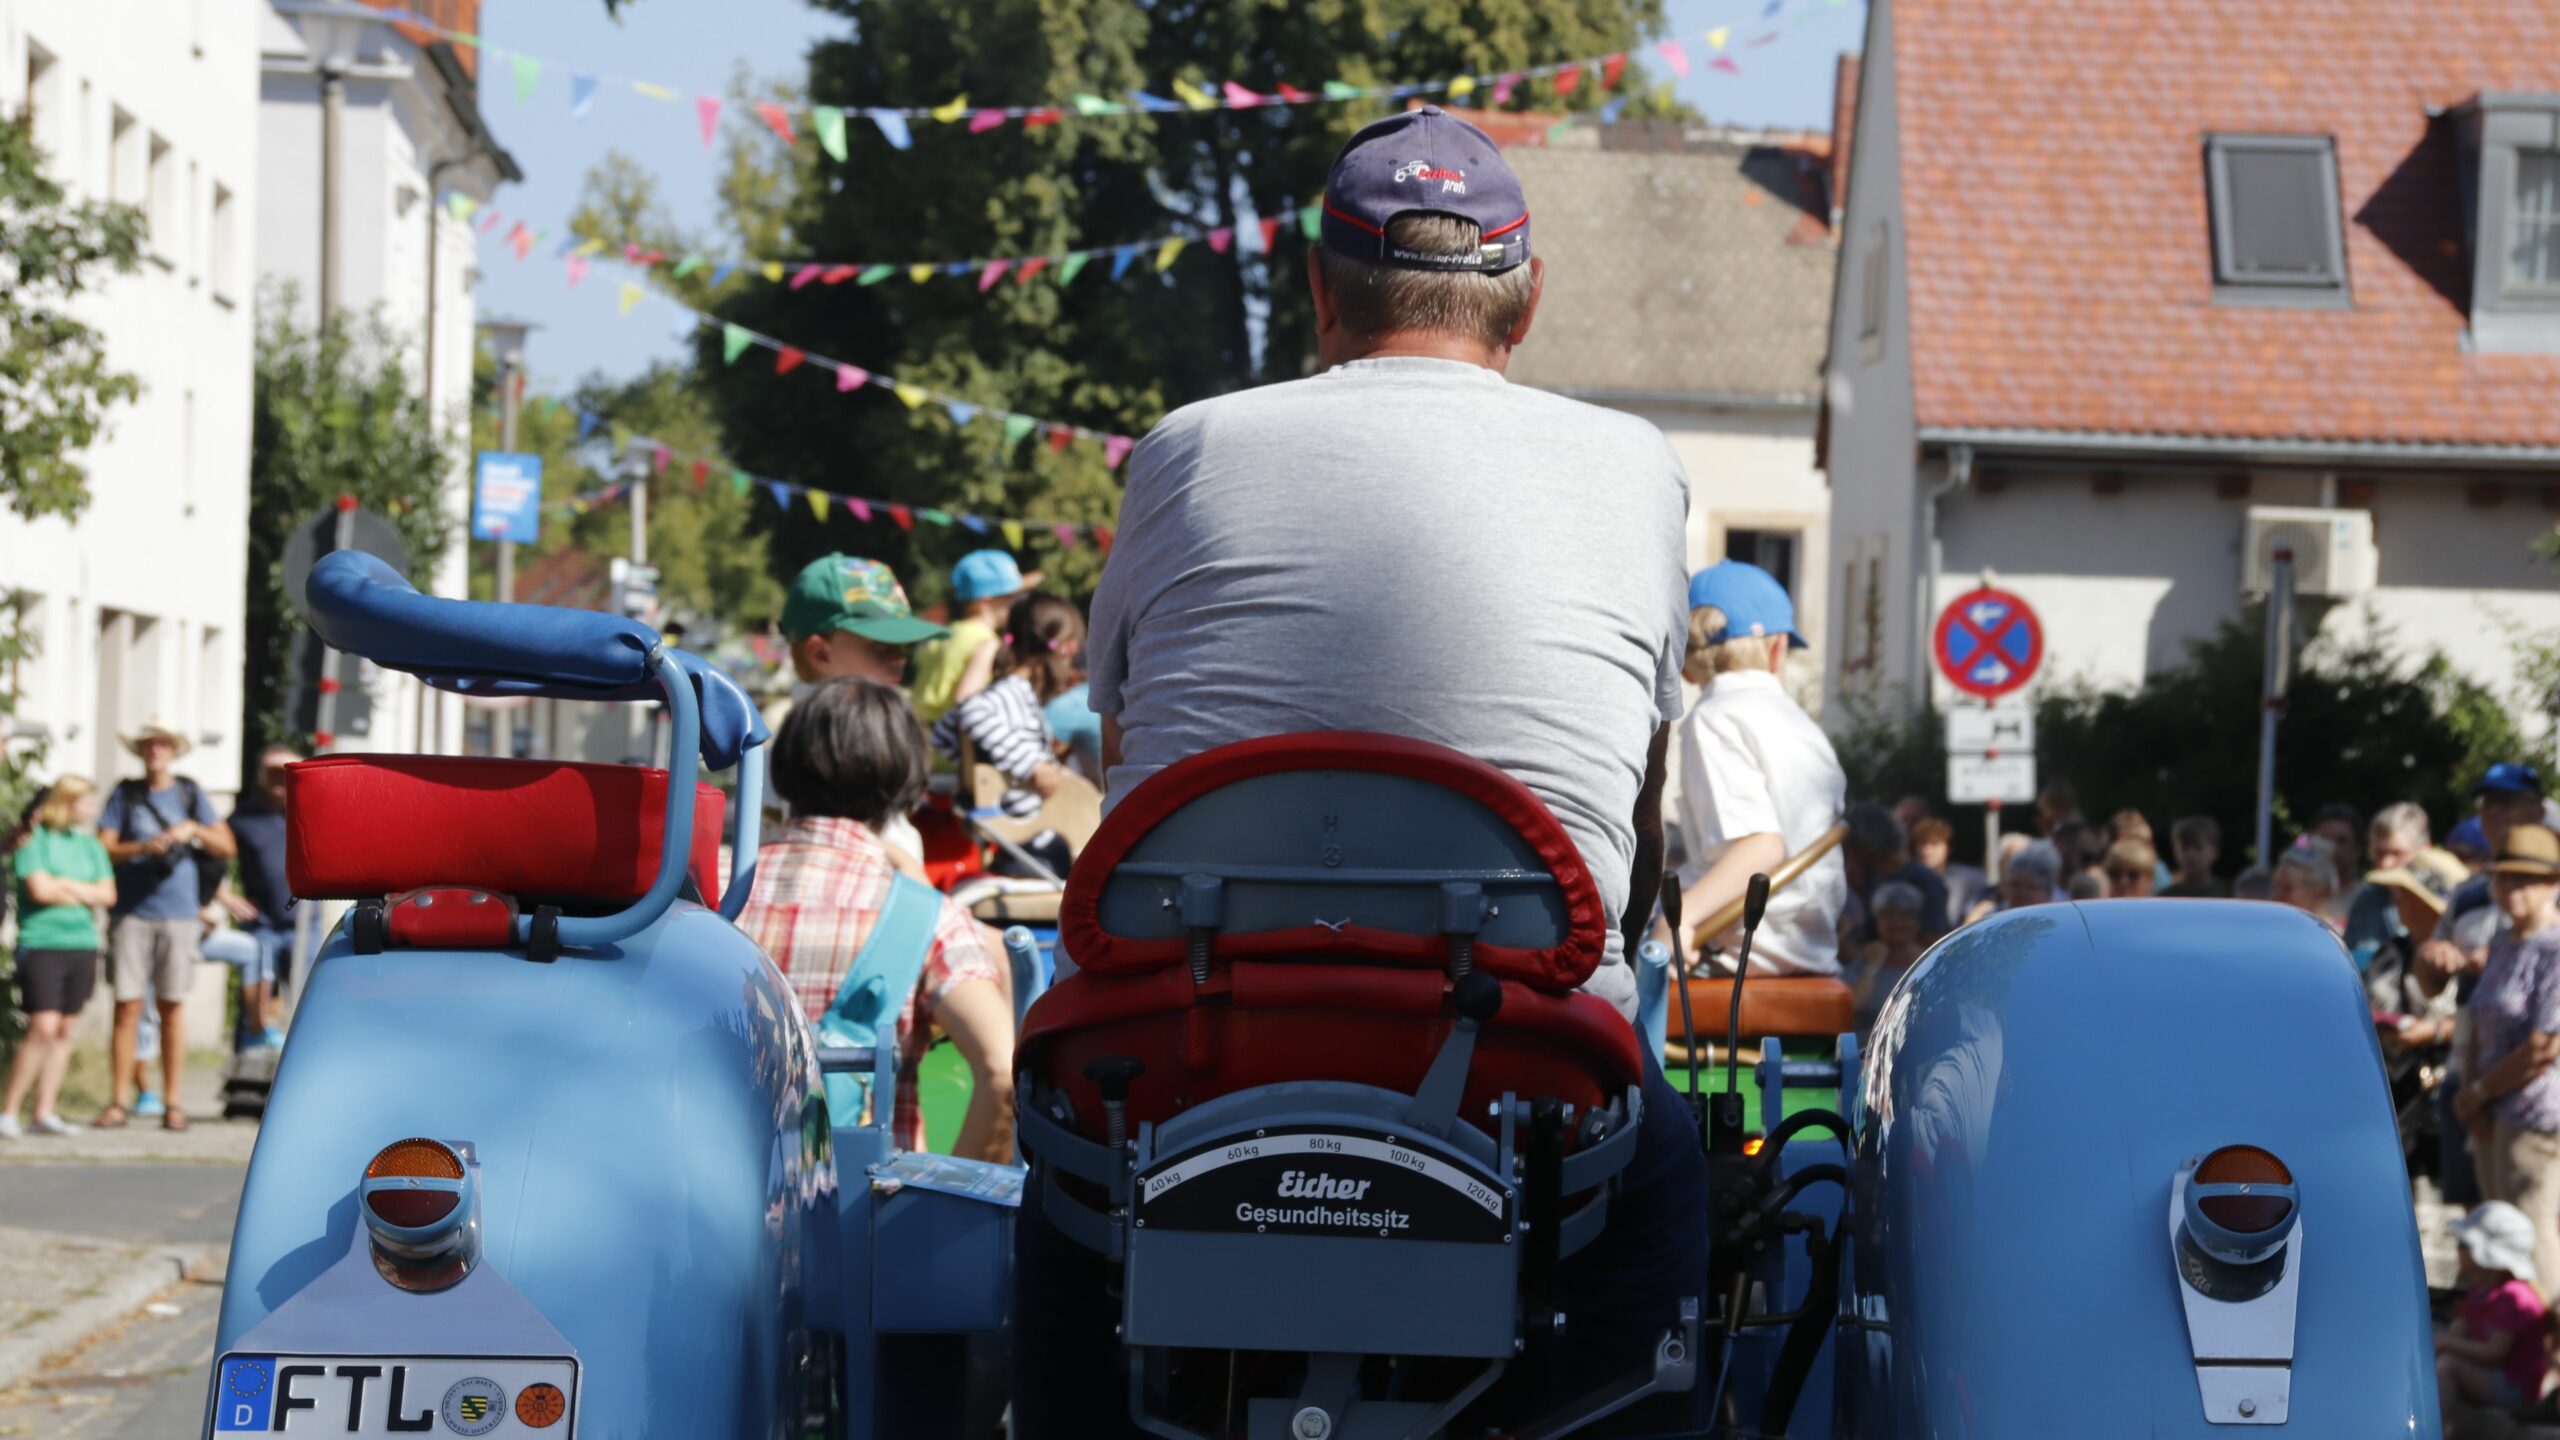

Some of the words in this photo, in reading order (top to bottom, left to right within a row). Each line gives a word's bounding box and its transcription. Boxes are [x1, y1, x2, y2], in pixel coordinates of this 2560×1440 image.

[1442, 179, 1466, 194] profi
[1227, 1147, 1242, 1160] 60
[1243, 1145, 1259, 1157] kg
[1309, 1138, 1324, 1149] 80
[1327, 1139, 1342, 1152] kg
[1390, 1149, 1410, 1164] 100
[1411, 1156, 1426, 1171] kg
[1151, 1178, 1165, 1192] 40
[1165, 1172, 1181, 1183] kg
[1277, 1170, 1372, 1200] Eicher
[1466, 1182, 1486, 1199] 120
[1484, 1194, 1499, 1211] kg
[1236, 1202, 1410, 1229] Gesundheitssitz
[273, 1365, 435, 1432] FTL
[234, 1404, 254, 1426] D
